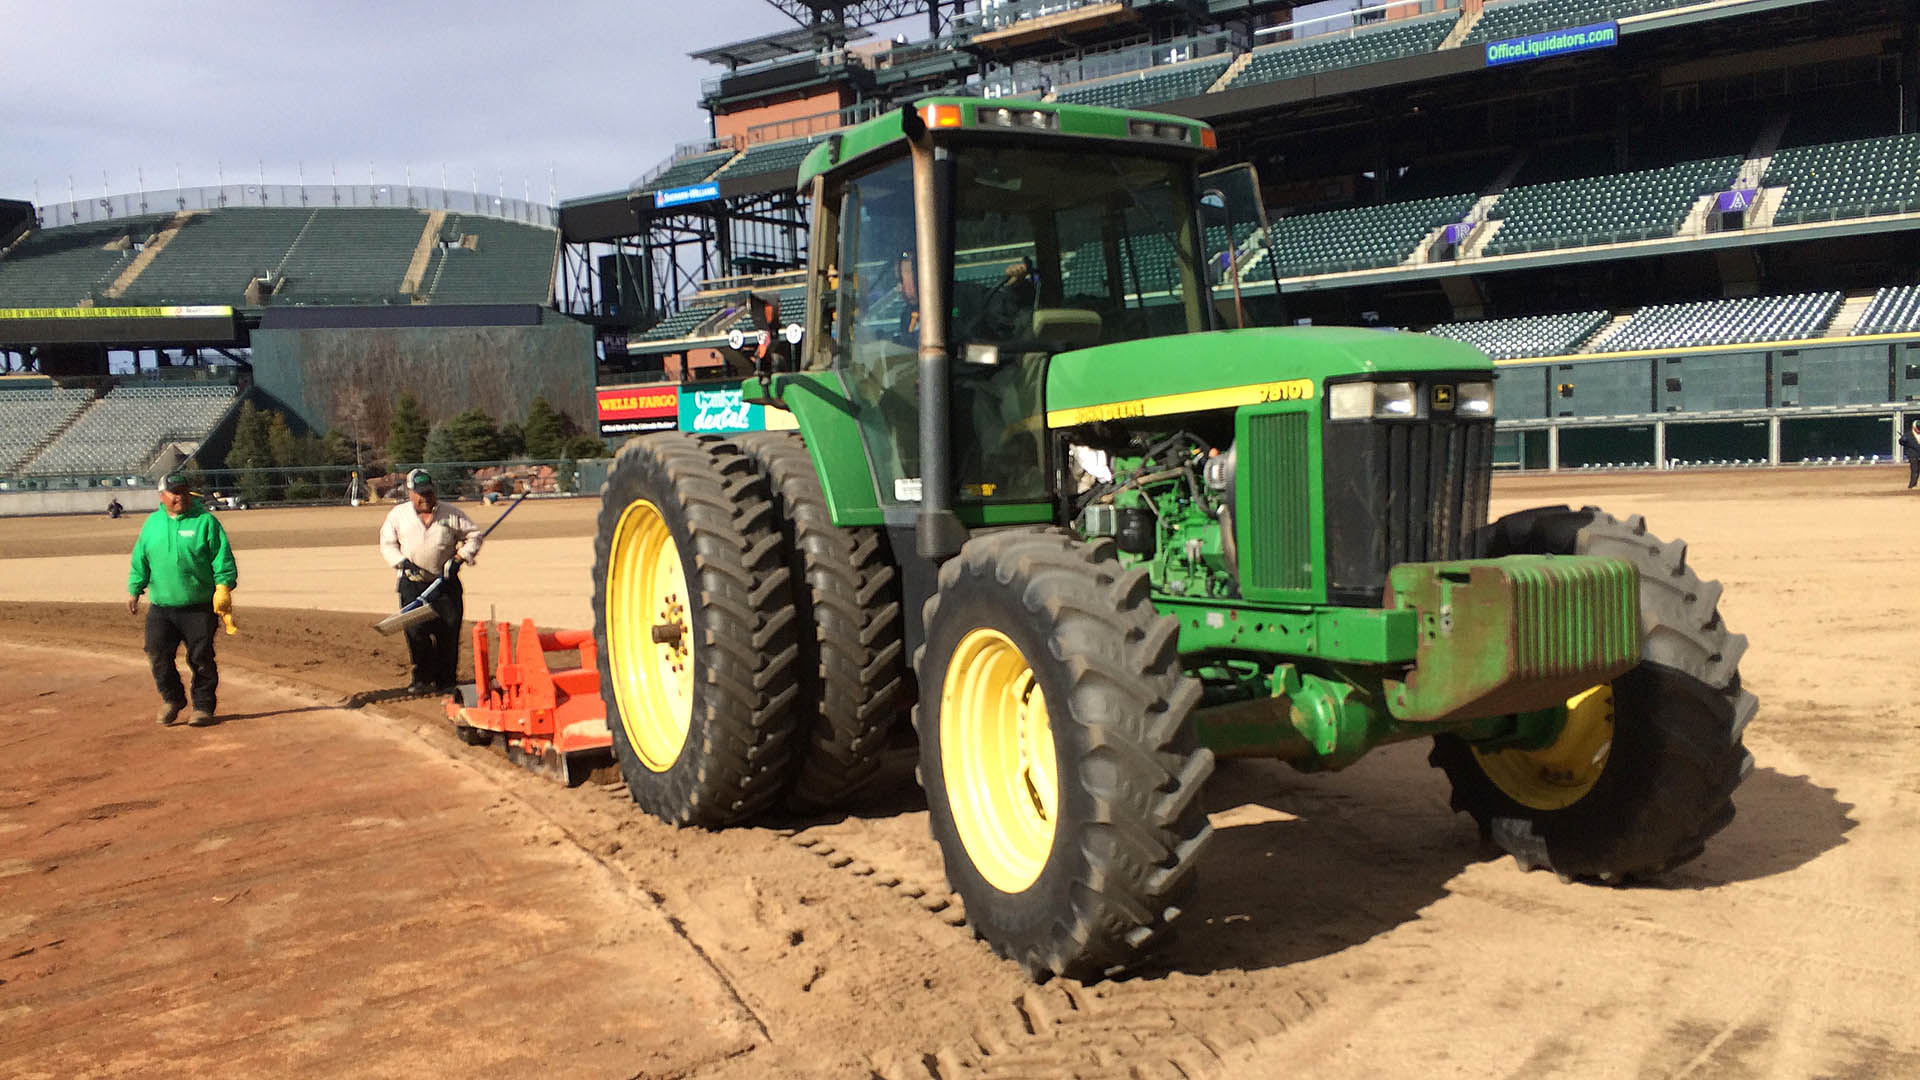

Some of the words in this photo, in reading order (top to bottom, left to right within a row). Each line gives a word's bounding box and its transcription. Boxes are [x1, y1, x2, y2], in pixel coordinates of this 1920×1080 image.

[1488, 28, 1614, 60] OfficeLiquidators.com
[110, 307, 138, 316] POWER
[140, 307, 162, 315] FROM
[600, 397, 638, 411] WELLS
[639, 394, 676, 409] FARGO
